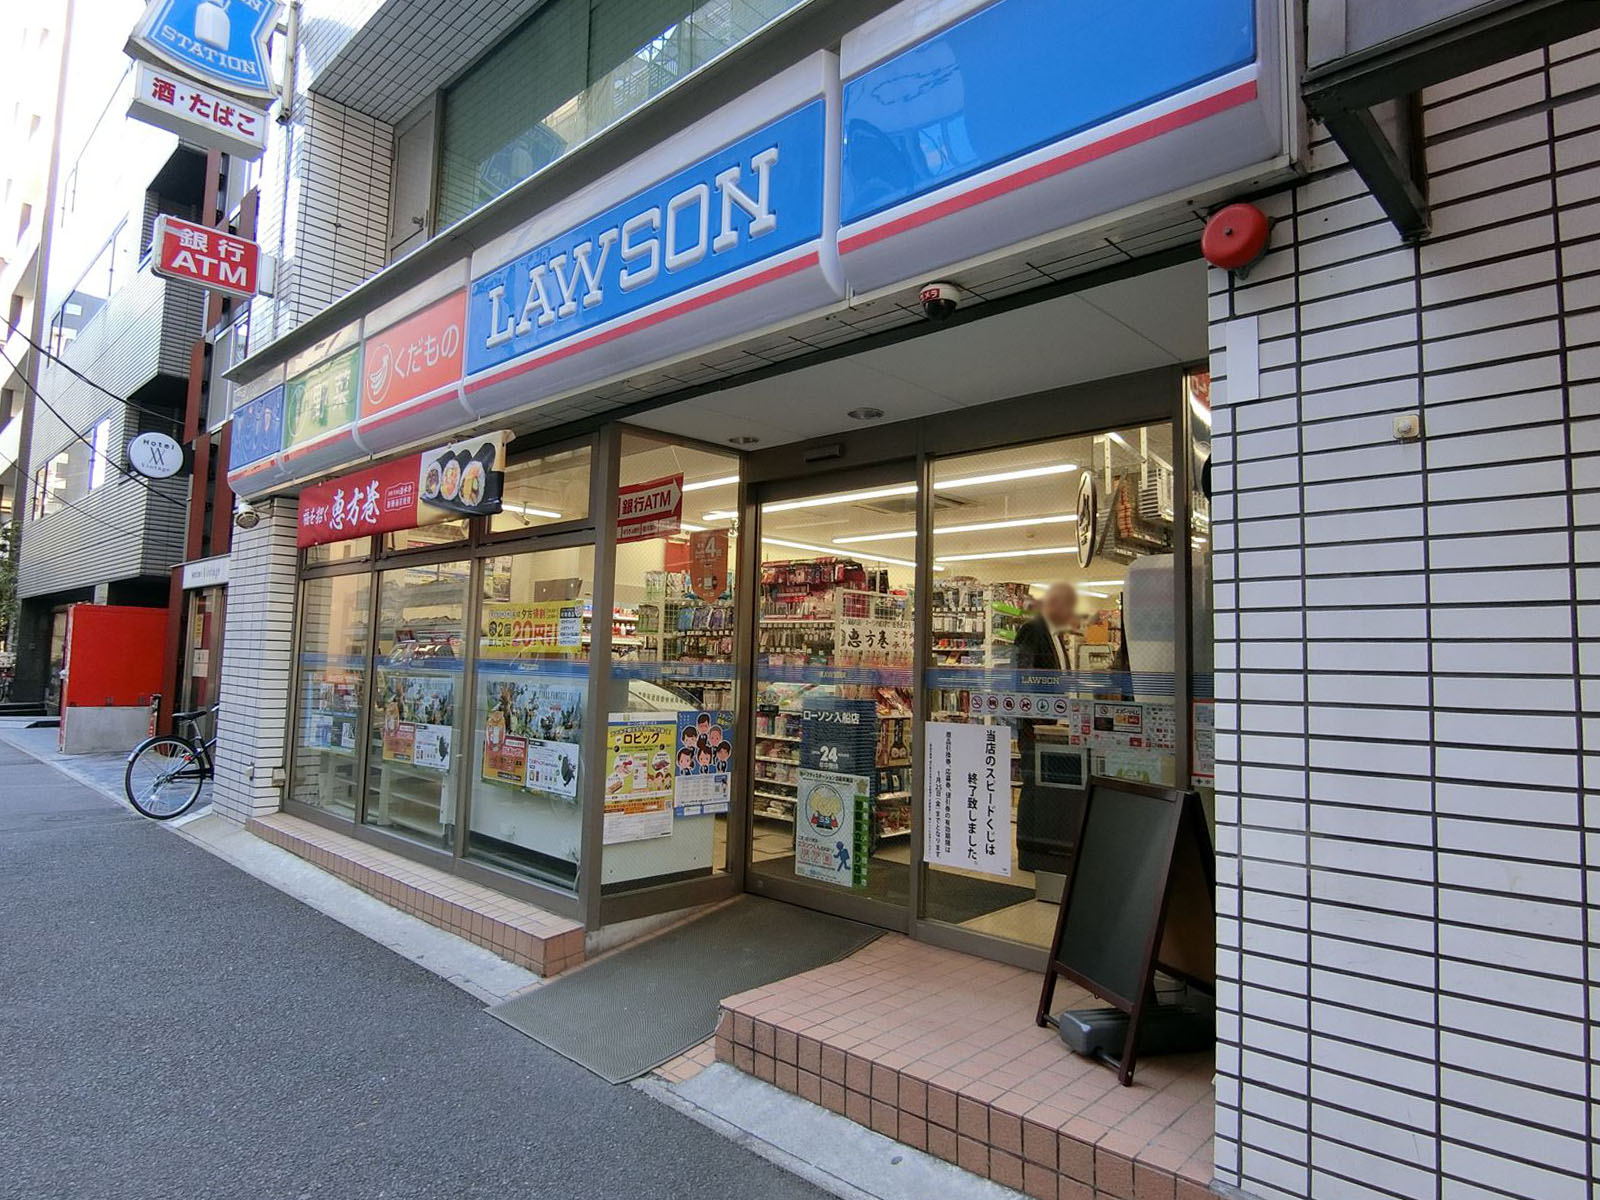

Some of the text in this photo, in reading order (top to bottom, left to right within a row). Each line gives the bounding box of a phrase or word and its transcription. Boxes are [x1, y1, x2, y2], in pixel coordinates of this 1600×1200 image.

[161, 25, 257, 75] STATION
[152, 76, 255, 137] 酒・たばこ
[179, 226, 245, 262] 銀行
[486, 146, 778, 349] LAWSON
[171, 251, 247, 287] ATM
[394, 324, 460, 378] くだもの
[329, 480, 380, 530] 恵方巻
[622, 490, 671, 515] 銀行ATM
[847, 628, 889, 649] 恵方巻
[1021, 676, 1060, 685] LAWSON
[803, 710, 860, 725] ローソン入船店
[623, 732, 660, 745] ロピック
[820, 745, 838, 762] 24
[985, 729, 997, 856] 当店のスピードくじは
